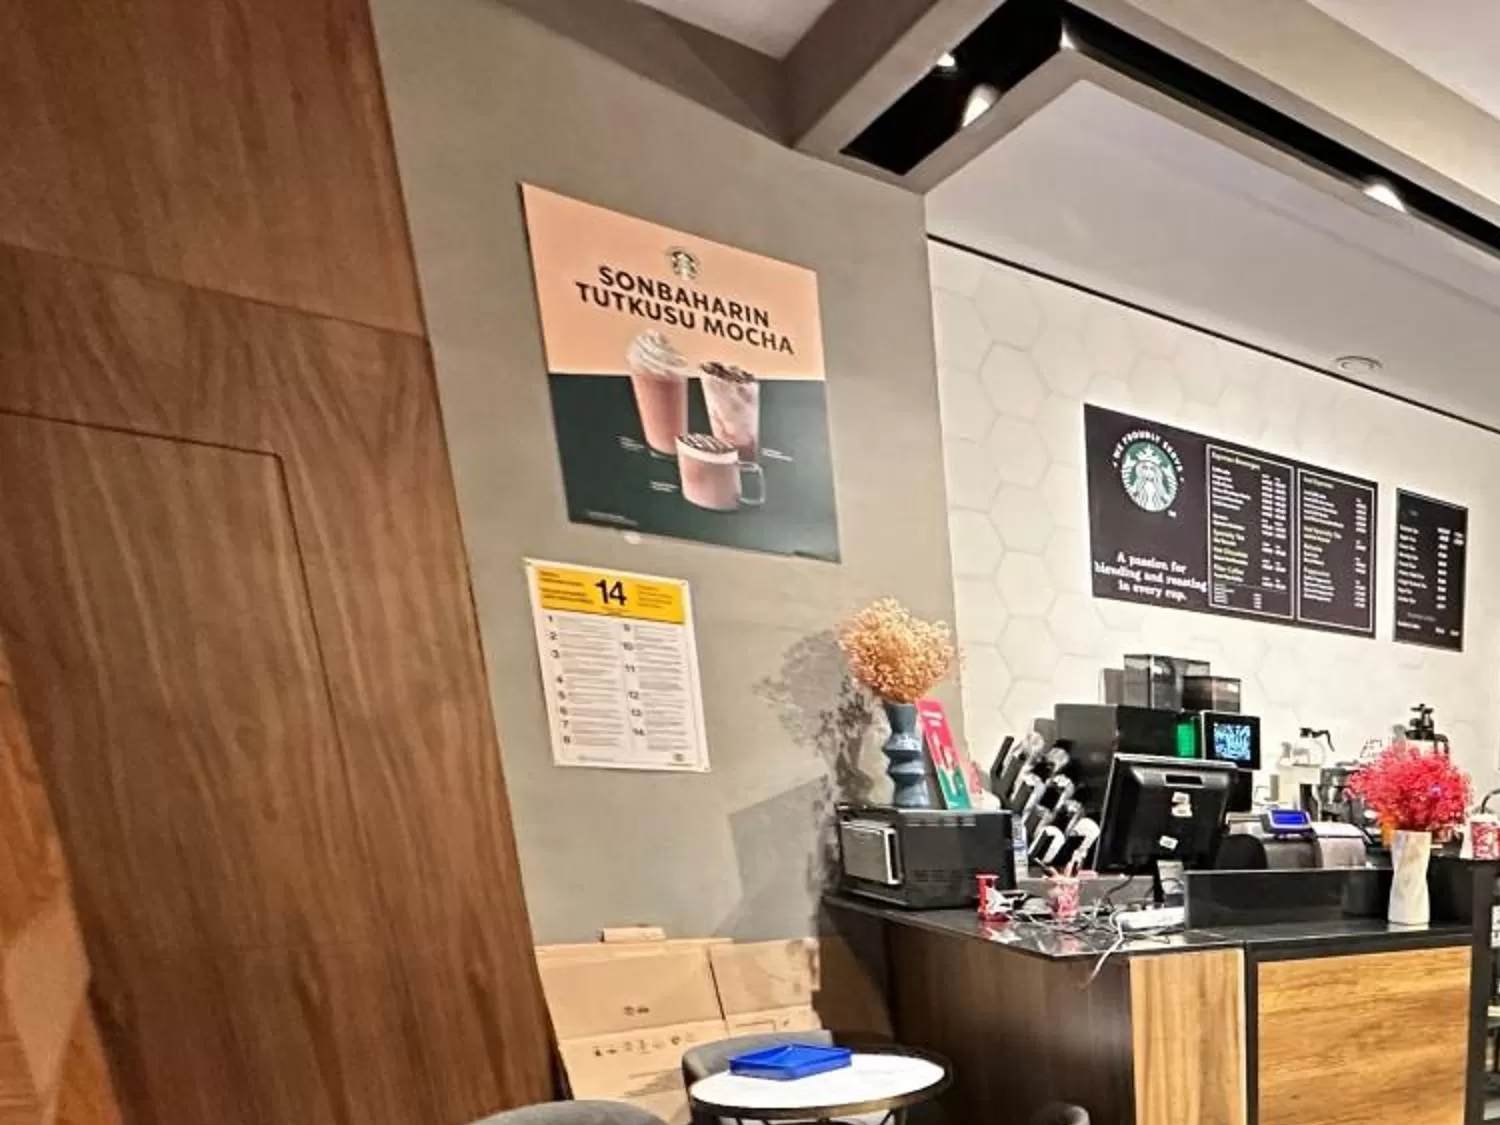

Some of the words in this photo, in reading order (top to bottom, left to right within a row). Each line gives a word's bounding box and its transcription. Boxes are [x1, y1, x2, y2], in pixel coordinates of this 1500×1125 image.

[598, 265, 769, 328] SONBAHARIN
[575, 281, 695, 329] TUTKUSU
[703, 315, 794, 355] MOCHA
[1094, 560, 1142, 582] blending
[1143, 571, 1164, 583] and
[1165, 575, 1207, 593] roasting
[1116, 551, 1127, 563] A
[1128, 555, 1169, 571] passion
[1171, 561, 1188, 574] for
[594, 579, 627, 606] 14
[1118, 578, 1131, 591] in
[1131, 583, 1163, 598] every
